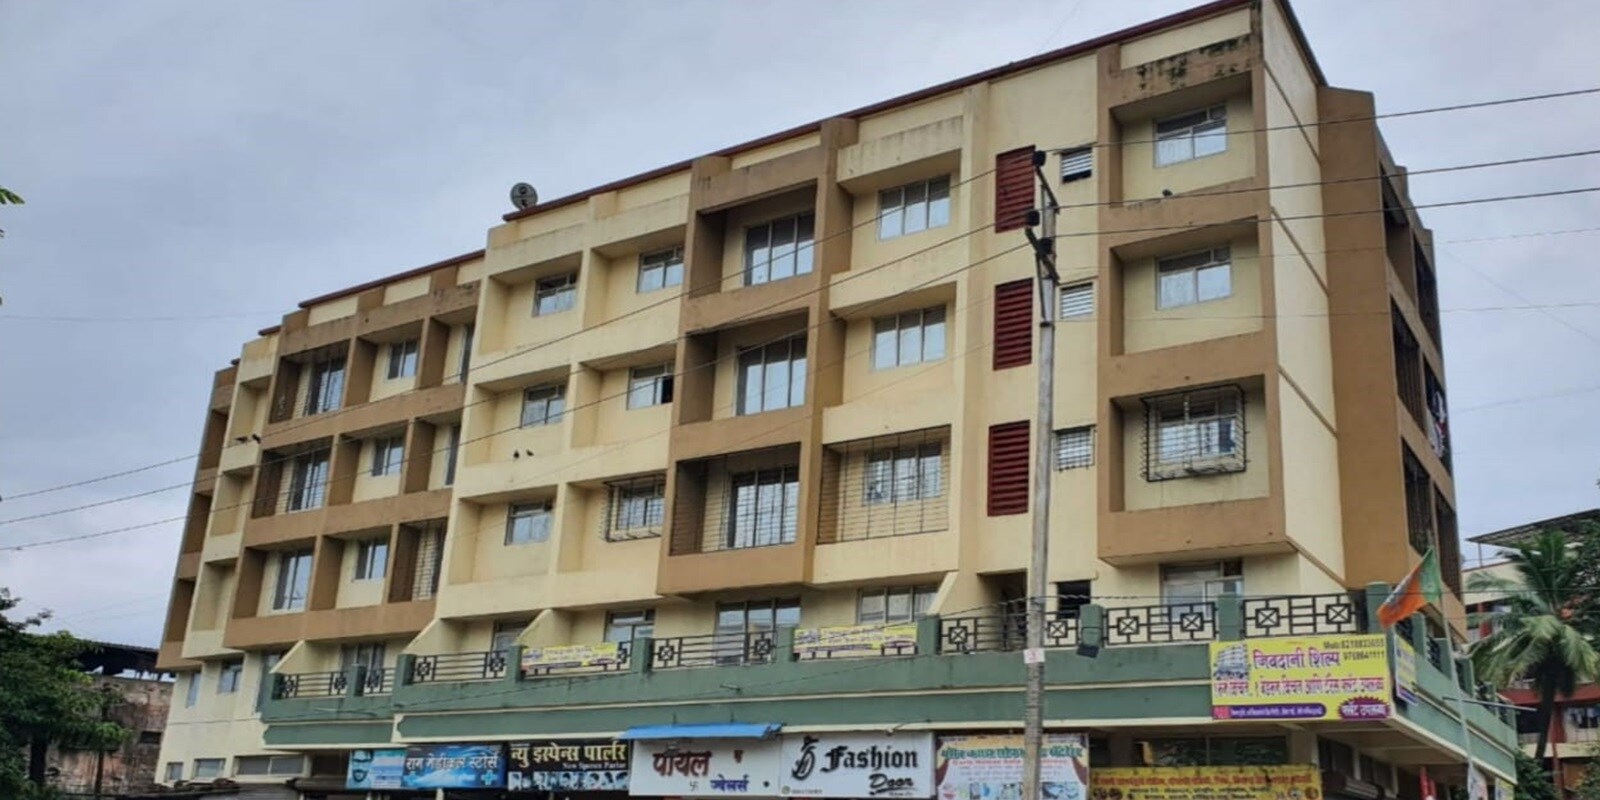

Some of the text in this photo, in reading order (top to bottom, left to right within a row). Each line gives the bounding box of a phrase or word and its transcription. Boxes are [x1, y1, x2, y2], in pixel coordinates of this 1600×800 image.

[1309, 646, 1340, 667] शिल्प
[584, 741, 627, 760] पार्लर
[820, 745, 919, 772] Fashion
[652, 750, 712, 776] पायल
